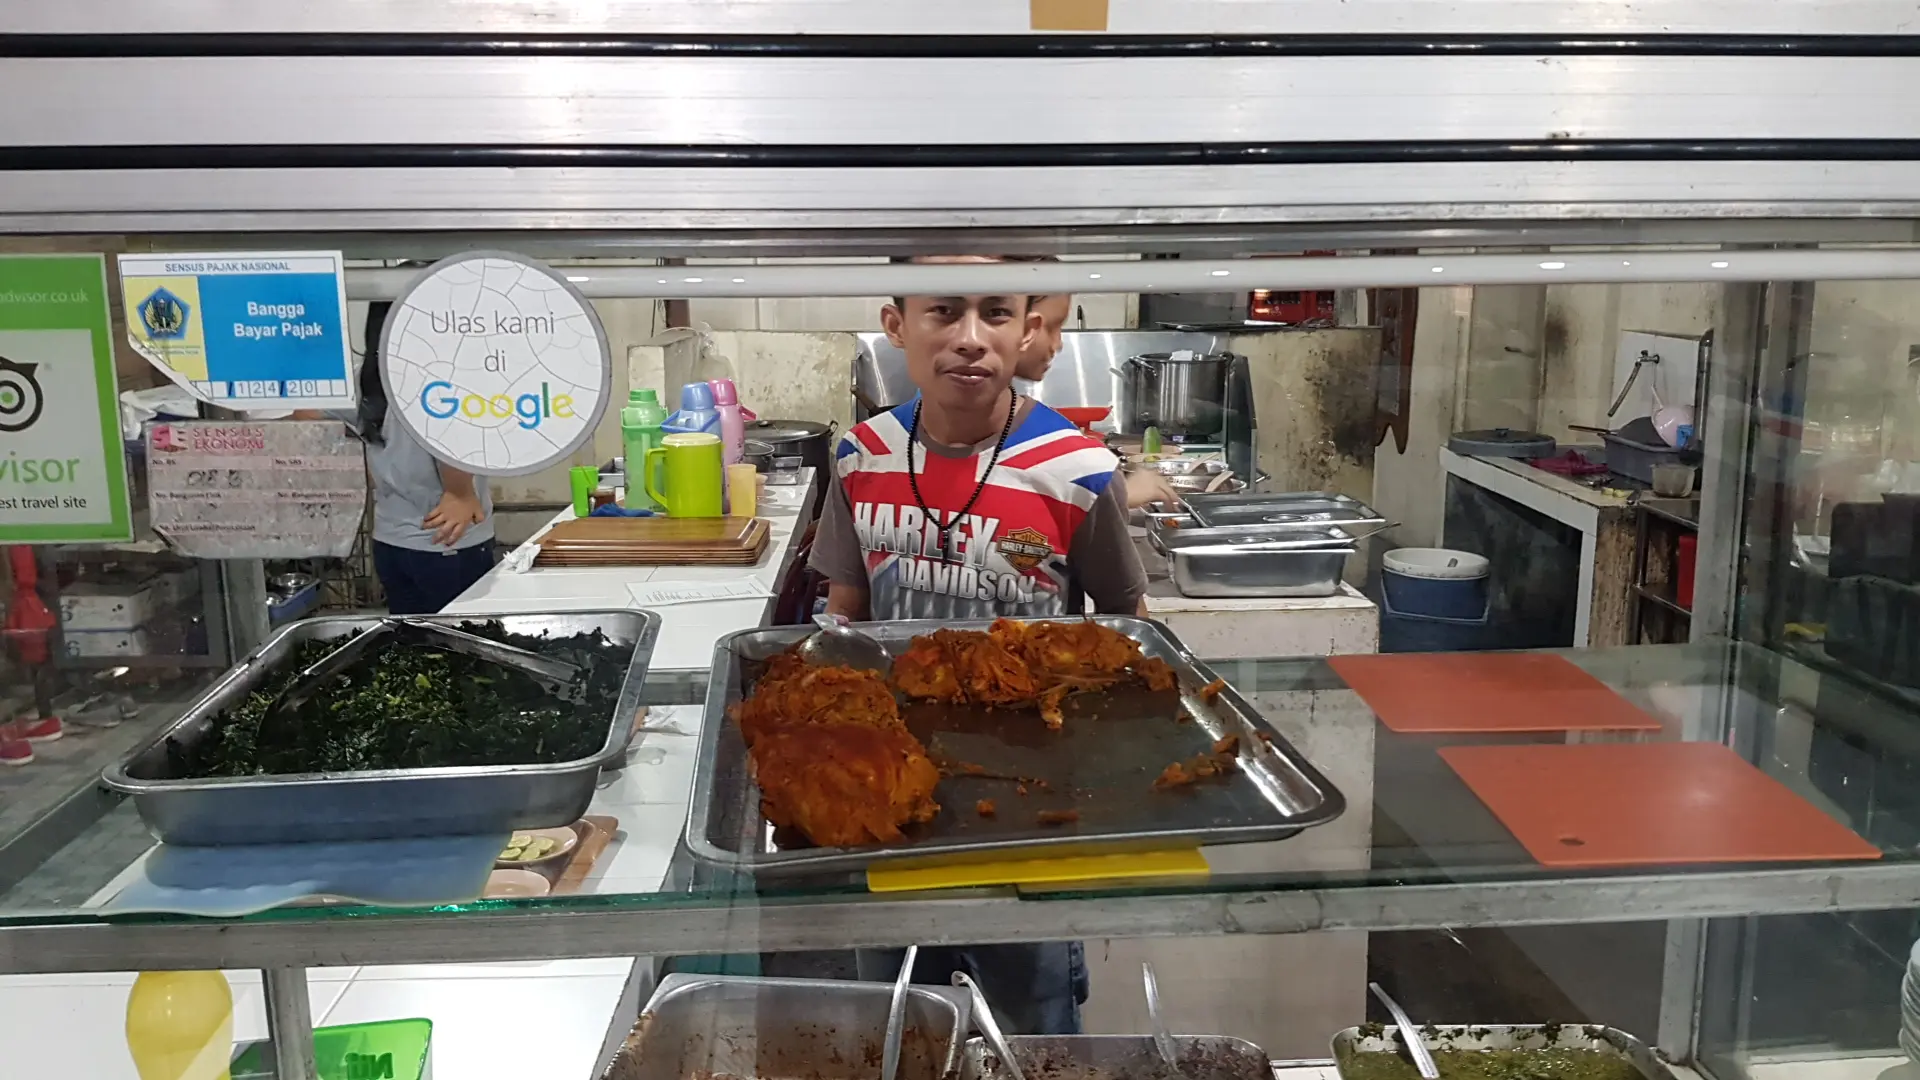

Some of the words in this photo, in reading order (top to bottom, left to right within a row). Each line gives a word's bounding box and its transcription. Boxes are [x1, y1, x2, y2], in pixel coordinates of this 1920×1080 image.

[165, 261, 206, 273] SENSUS
[207, 261, 239, 272] PAJAK
[241, 260, 291, 272] NASIONAL
[247, 301, 306, 319] Bangga
[233, 323, 277, 342] Bayar
[281, 321, 323, 341] Pajak
[430, 310, 486, 334] Ulas
[494, 310, 555, 334] kami
[484, 349, 506, 372] di
[420, 380, 574, 430] Google
[193, 427, 264, 438] SENSUS
[194, 438, 265, 450] EKONOMI
[22, 495, 59, 509] travel
[63, 495, 87, 508] site
[854, 501, 1000, 568] HARLEY
[898, 556, 1036, 603] DAVIDSON
